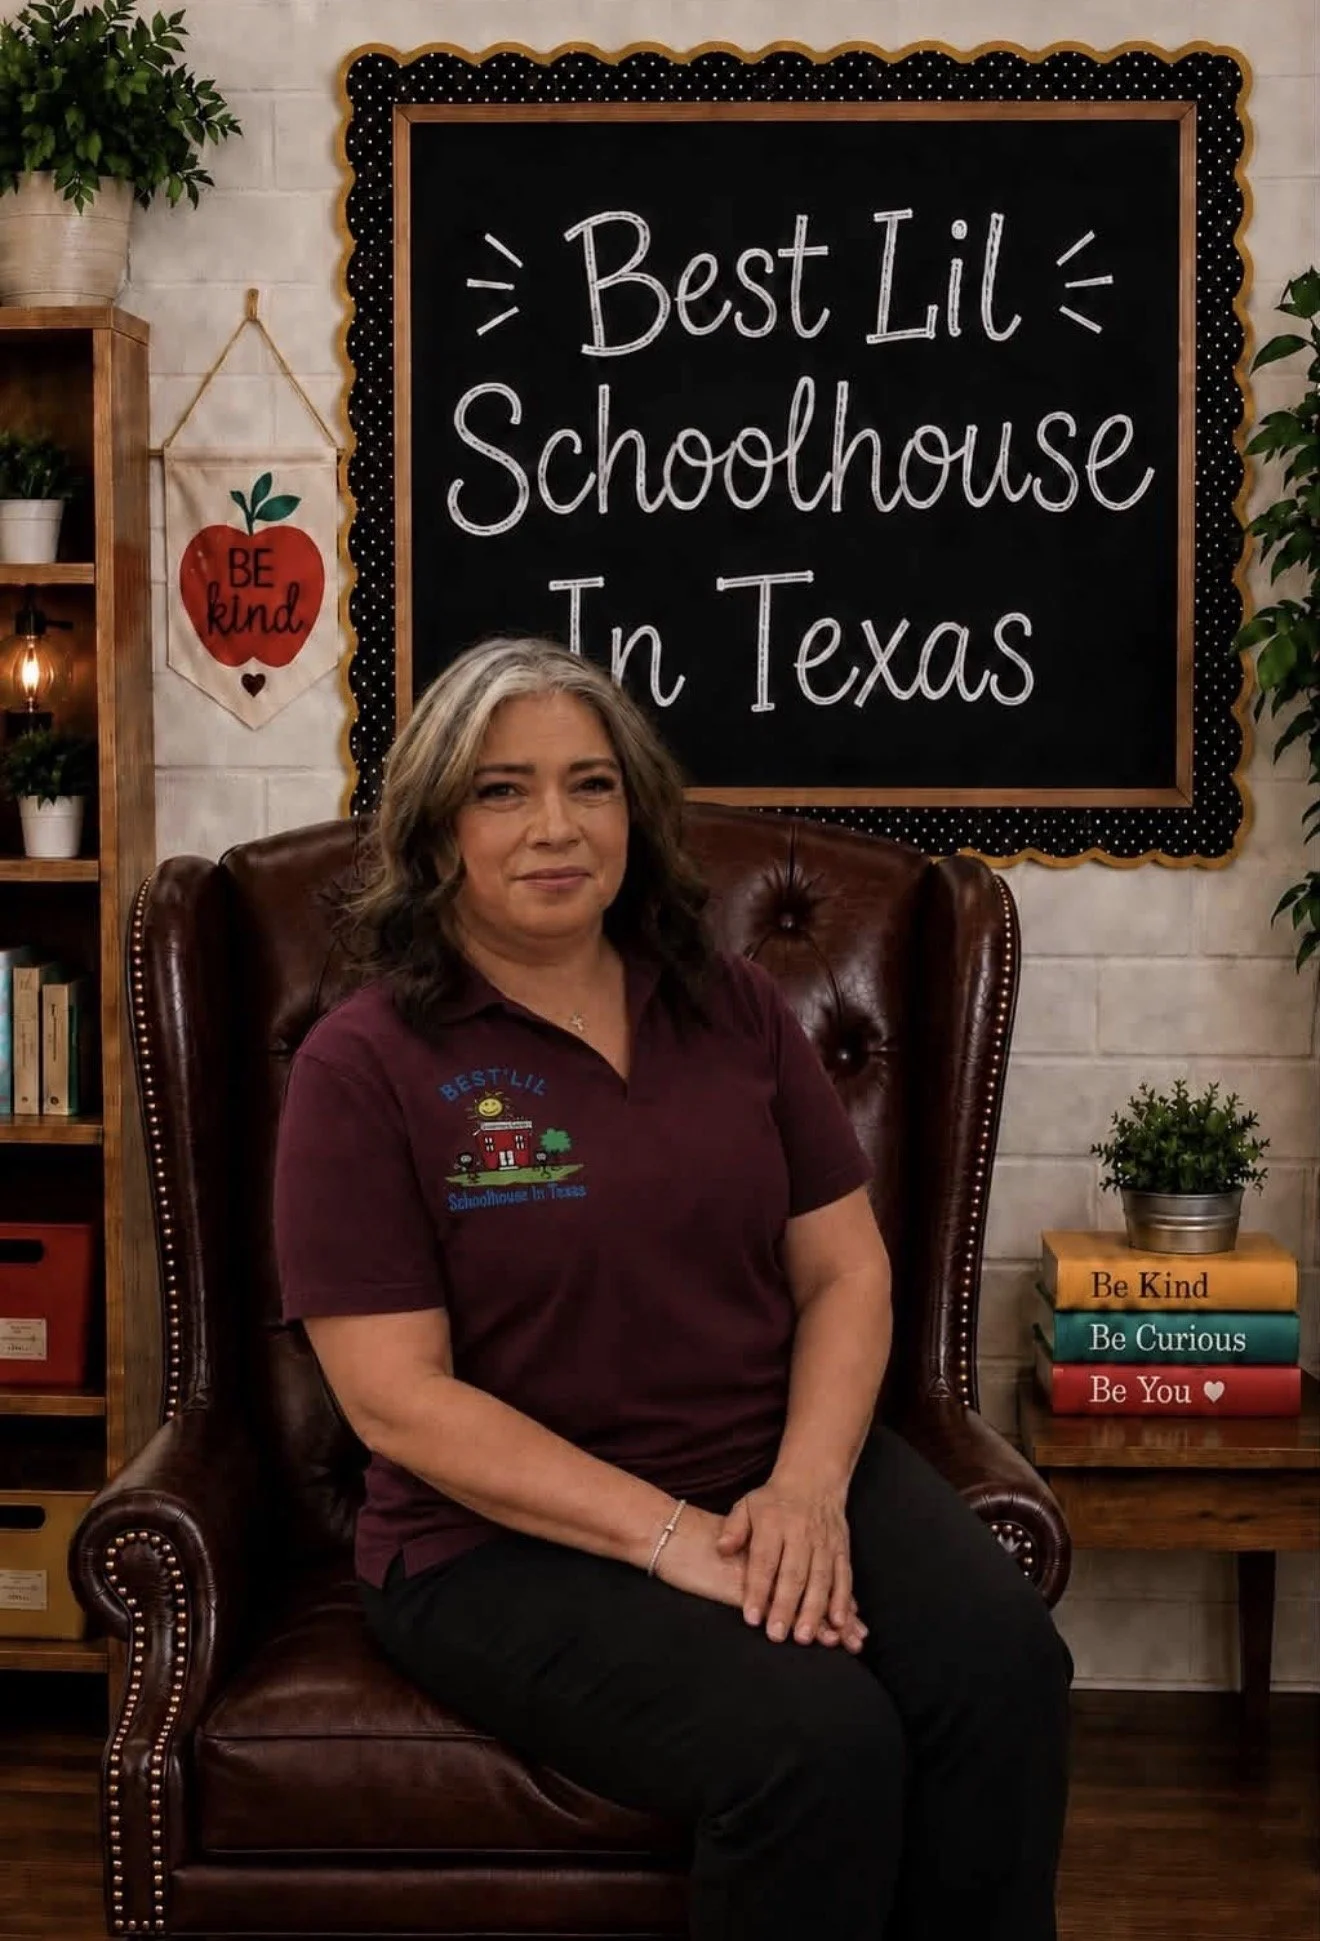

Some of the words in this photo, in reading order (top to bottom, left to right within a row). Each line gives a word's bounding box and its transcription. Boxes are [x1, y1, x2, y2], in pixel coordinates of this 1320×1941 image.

[564, 211, 829, 356] Best
[866, 209, 1021, 344] Lil
[448, 376, 1154, 535] Schoolhouse
[228, 548, 275, 588] BE
[206, 581, 304, 636] kind
[549, 576, 685, 706] In
[717, 570, 1033, 712] Texas
[448, 1188, 527, 1211] Schoolhouse
[1091, 1271, 1129, 1299] Be
[1138, 1271, 1209, 1299] Kind
[1089, 1323, 1126, 1351] Be
[1136, 1323, 1246, 1352] Curious
[1090, 1375, 1127, 1403] Be
[1136, 1375, 1192, 1404] You
